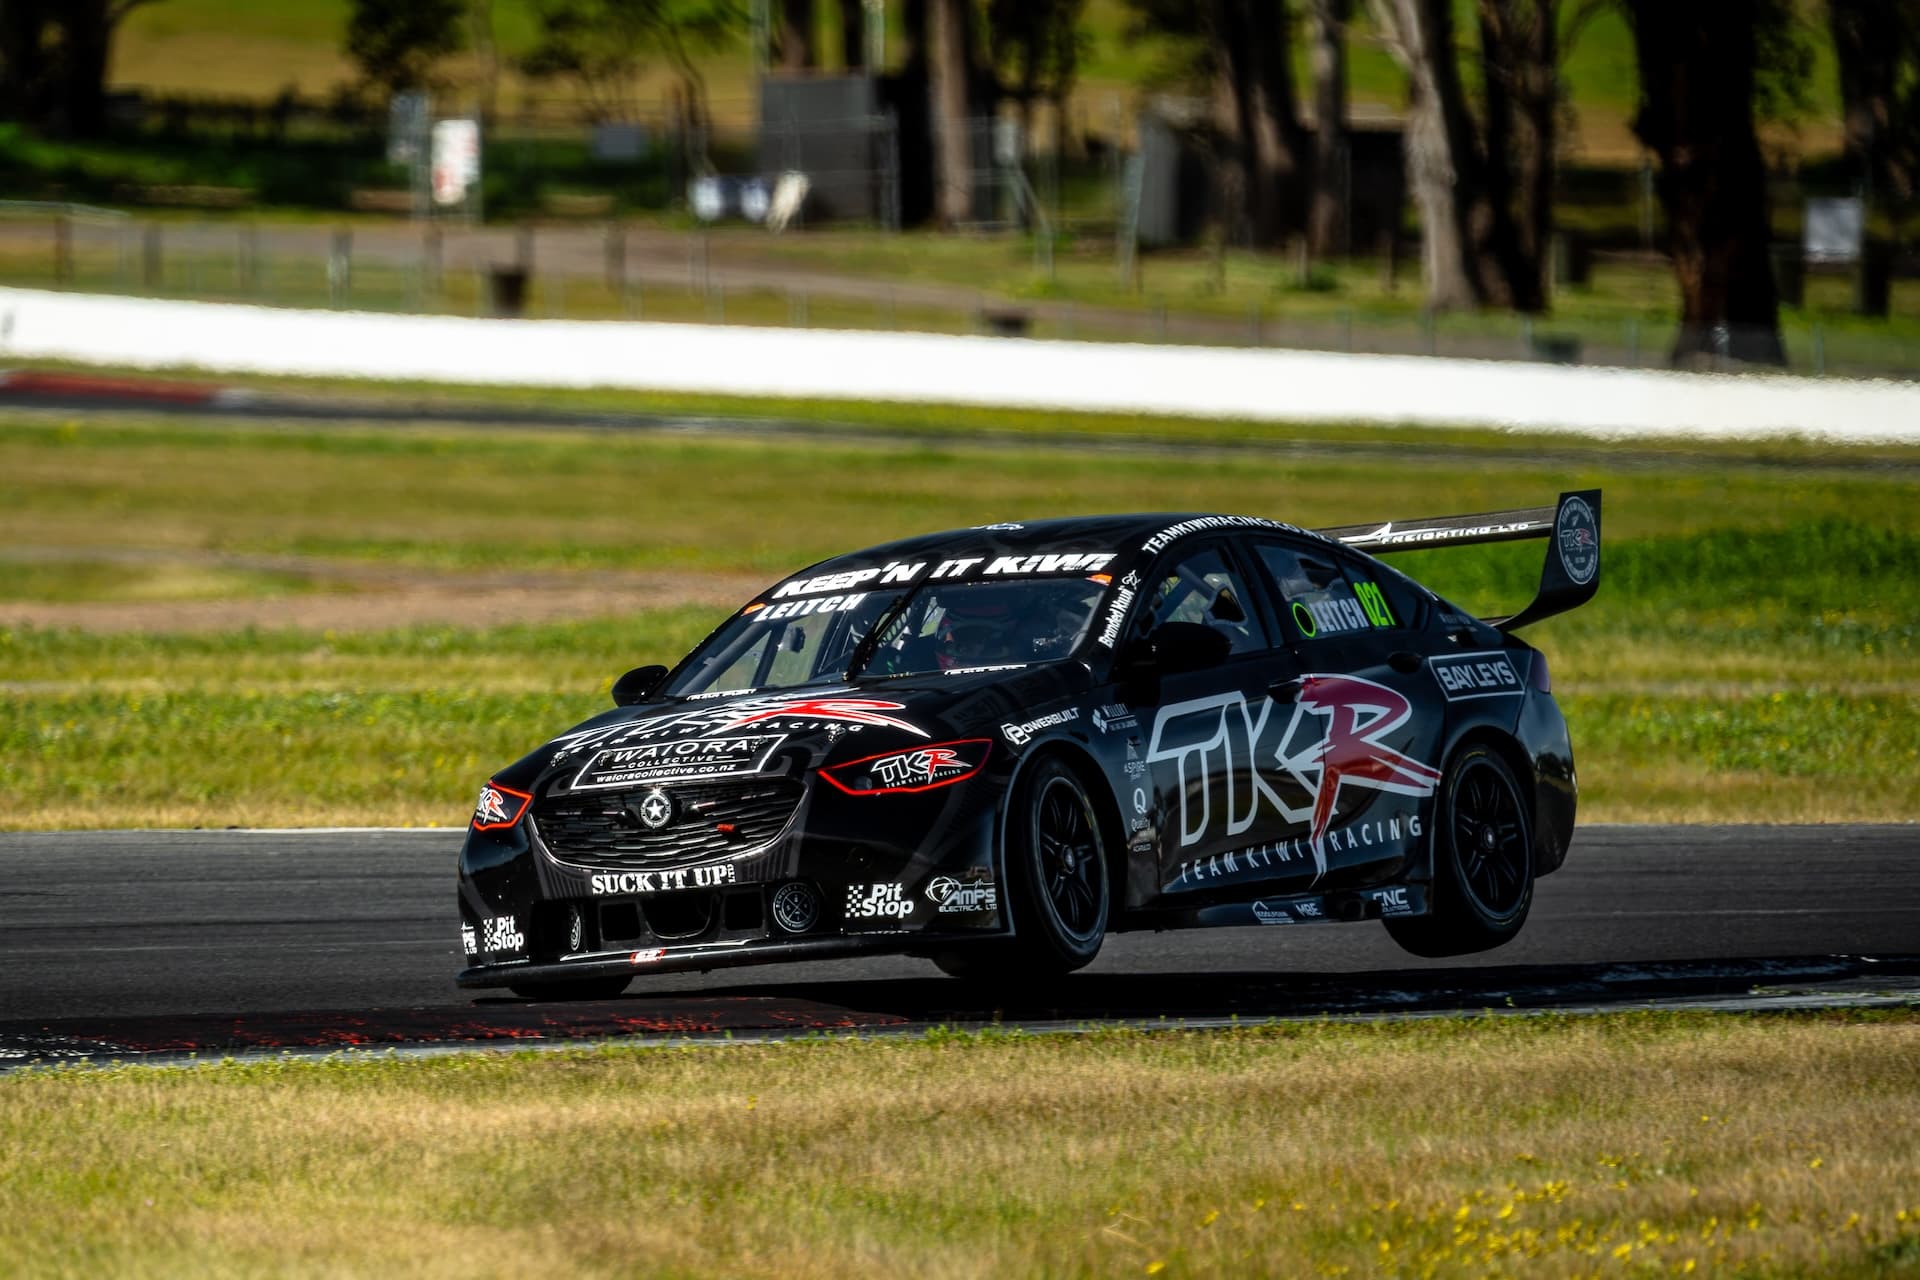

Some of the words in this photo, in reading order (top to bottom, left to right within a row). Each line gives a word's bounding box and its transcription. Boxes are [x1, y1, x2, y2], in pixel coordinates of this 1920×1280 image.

[1381, 525, 1490, 544] FREIGHTING
[1498, 522, 1530, 533] LTD
[771, 561, 928, 599] KEEP'N
[929, 557, 985, 579] IT
[982, 553, 1119, 575] KIWI
[752, 593, 869, 622] LEITCH
[1309, 598, 1370, 633] LEITCH
[1353, 581, 1396, 627] 021
[1436, 660, 1517, 691] BAYLEYS
[1000, 707, 1080, 745] POWERBUILT
[612, 740, 748, 763] WAIORA
[628, 755, 715, 769] COLLECTIVE
[596, 763, 736, 783] waioracollective.co.nz
[870, 748, 973, 784] TKR
[1133, 787, 1147, 815] Q
[1180, 850, 1239, 884] TEAM
[1246, 838, 1304, 869] KIWI
[1330, 814, 1423, 852] RACING
[591, 873, 656, 895] SUCK
[659, 870, 688, 891] IT
[693, 864, 727, 887] UP
[870, 882, 904, 902] Pit
[943, 887, 997, 906] AMPS
[861, 896, 916, 919] Stop
[938, 903, 983, 913] ELECTRICAL
[985, 903, 998, 912] LTD
[496, 914, 516, 935] Pit
[493, 930, 525, 952] Stop
